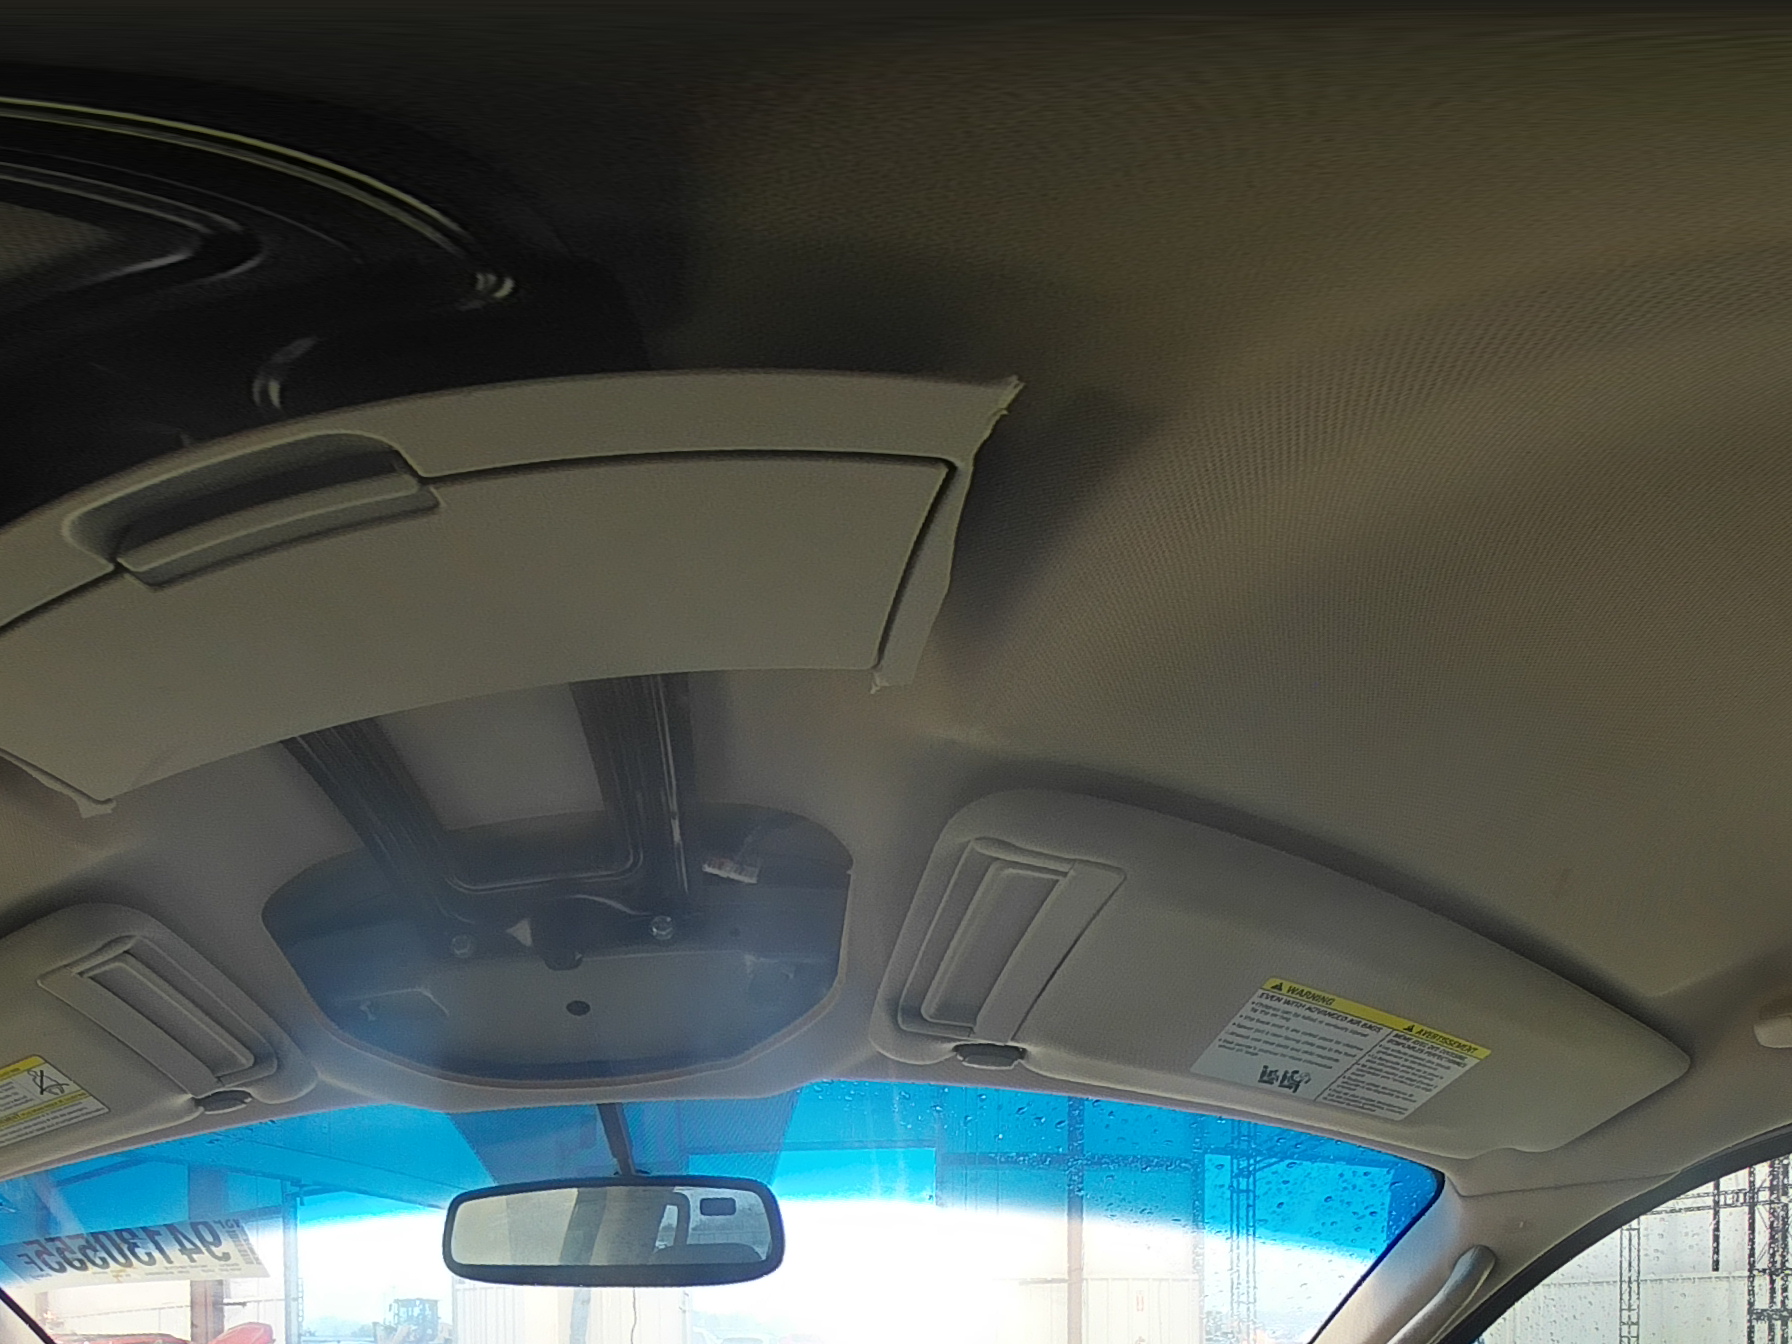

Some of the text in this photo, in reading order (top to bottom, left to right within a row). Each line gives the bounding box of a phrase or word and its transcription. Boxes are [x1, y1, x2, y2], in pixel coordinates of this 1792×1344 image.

[1258, 992, 1284, 1004] EVEN
[1286, 985, 1335, 1006] WARNING
[1416, 1028, 1478, 1054] AVERTISSEMENT
